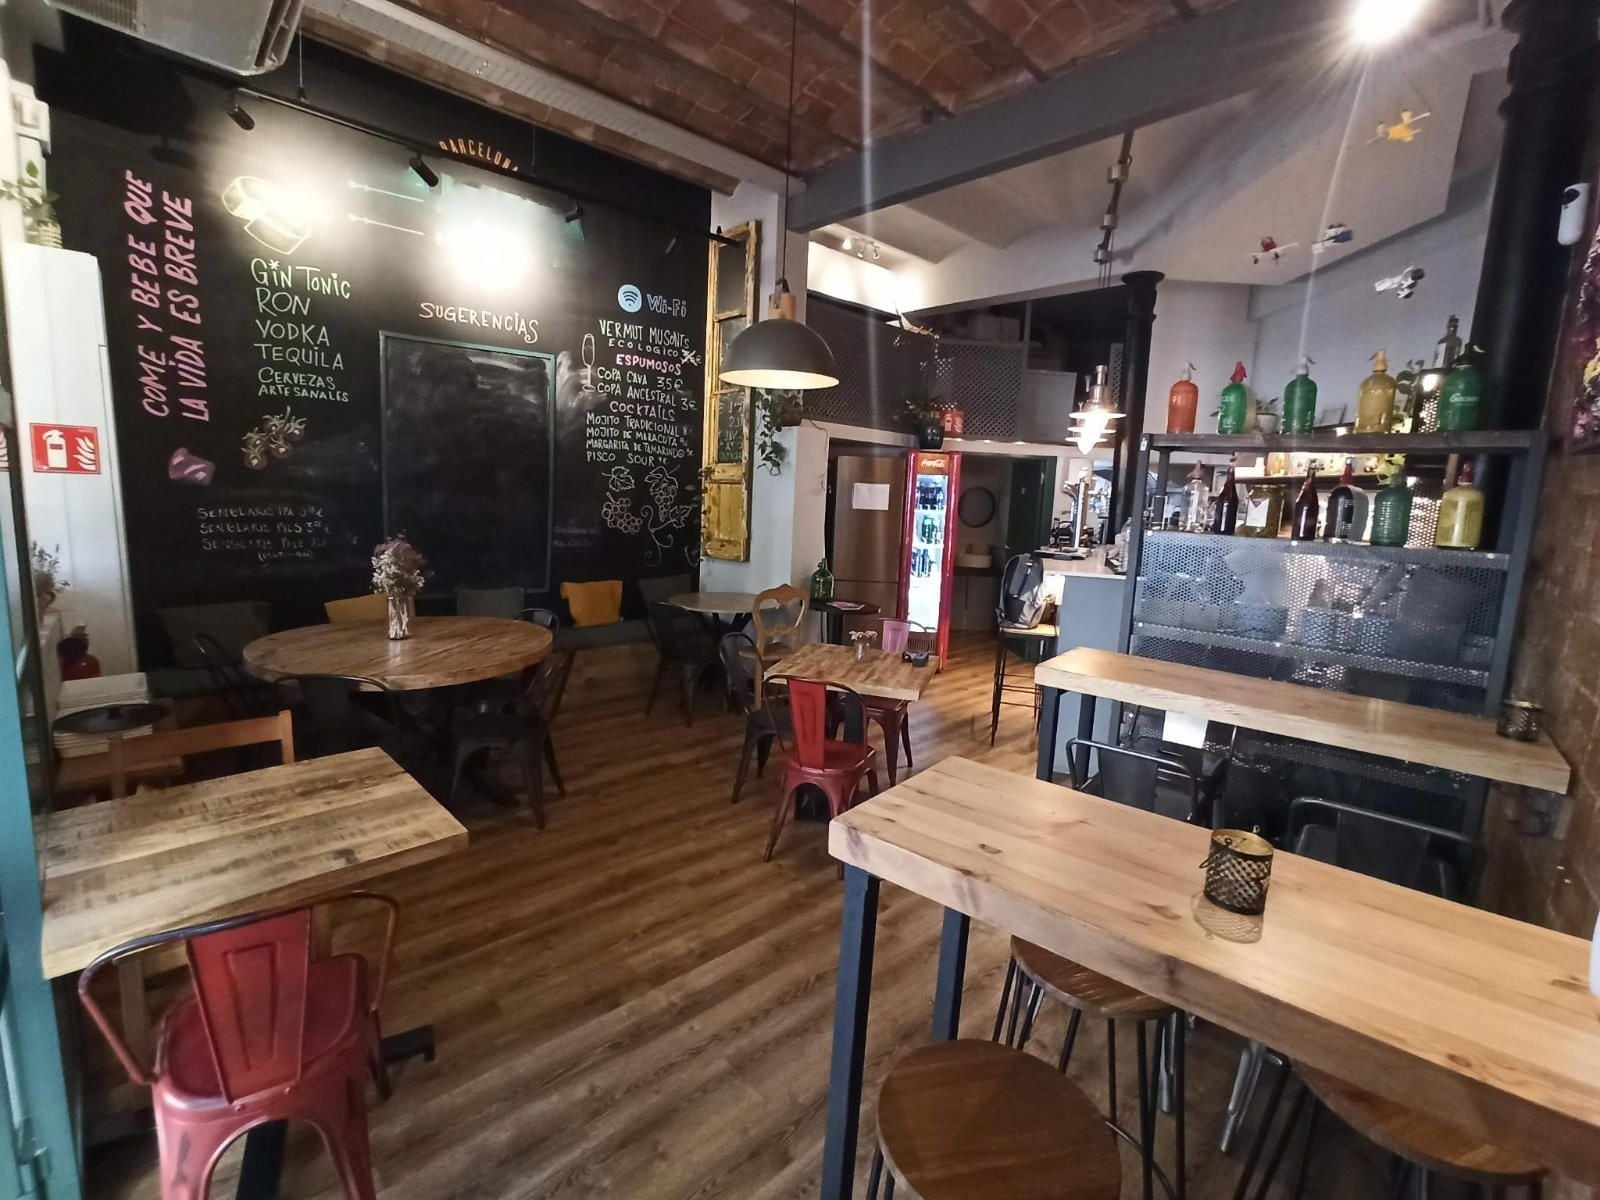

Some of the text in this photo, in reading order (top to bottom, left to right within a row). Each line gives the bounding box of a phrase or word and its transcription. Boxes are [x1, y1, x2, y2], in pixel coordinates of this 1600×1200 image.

[124, 169, 170, 417] COME Y BEBE QUE
[255, 287, 310, 317] RON
[162, 190, 210, 422] LA VIDA ES BREVE
[255, 319, 330, 347] VODKA
[599, 319, 643, 341] VERMUT
[254, 343, 344, 370] TEQUILA
[608, 338, 679, 357] ECOLOGICO
[597, 366, 622, 381] COPA
[626, 371, 648, 385] CAVA
[616, 354, 681, 376] ESPUMOSOS
[258, 366, 336, 390] CERVEZAS
[258, 384, 349, 402] ARTESANALES
[597, 382, 622, 396] COPA
[627, 386, 676, 407] ANCESTRAL
[609, 401, 675, 421] COCKTAILS
[586, 412, 620, 425] MOJITO
[624, 415, 680, 437] TRADICIONAL
[586, 427, 620, 438] MOJITO
[586, 438, 630, 451] MARGARITA
[587, 451, 616, 462] PISCO
[626, 453, 655, 467] SOUR
